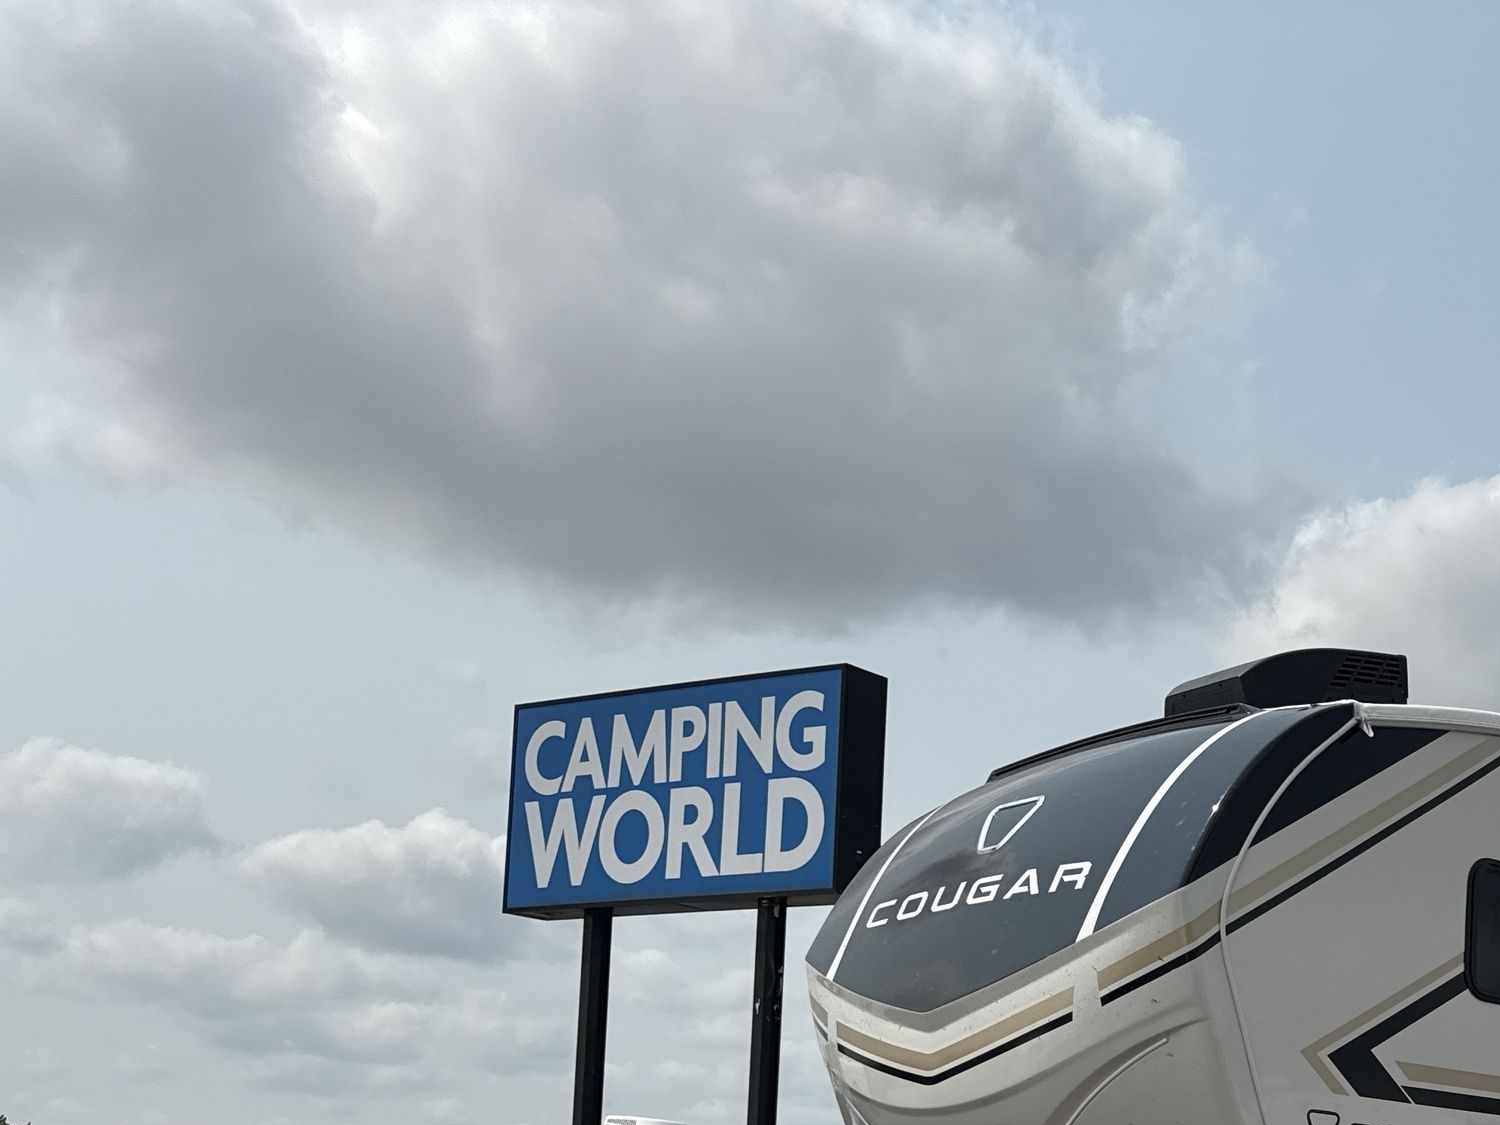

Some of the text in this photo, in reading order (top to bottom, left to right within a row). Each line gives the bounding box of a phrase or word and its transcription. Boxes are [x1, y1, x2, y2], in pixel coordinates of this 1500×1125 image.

[524, 690, 827, 795] CAMPING
[524, 777, 826, 888] WORLD
[866, 860, 1093, 929] COUGAR
